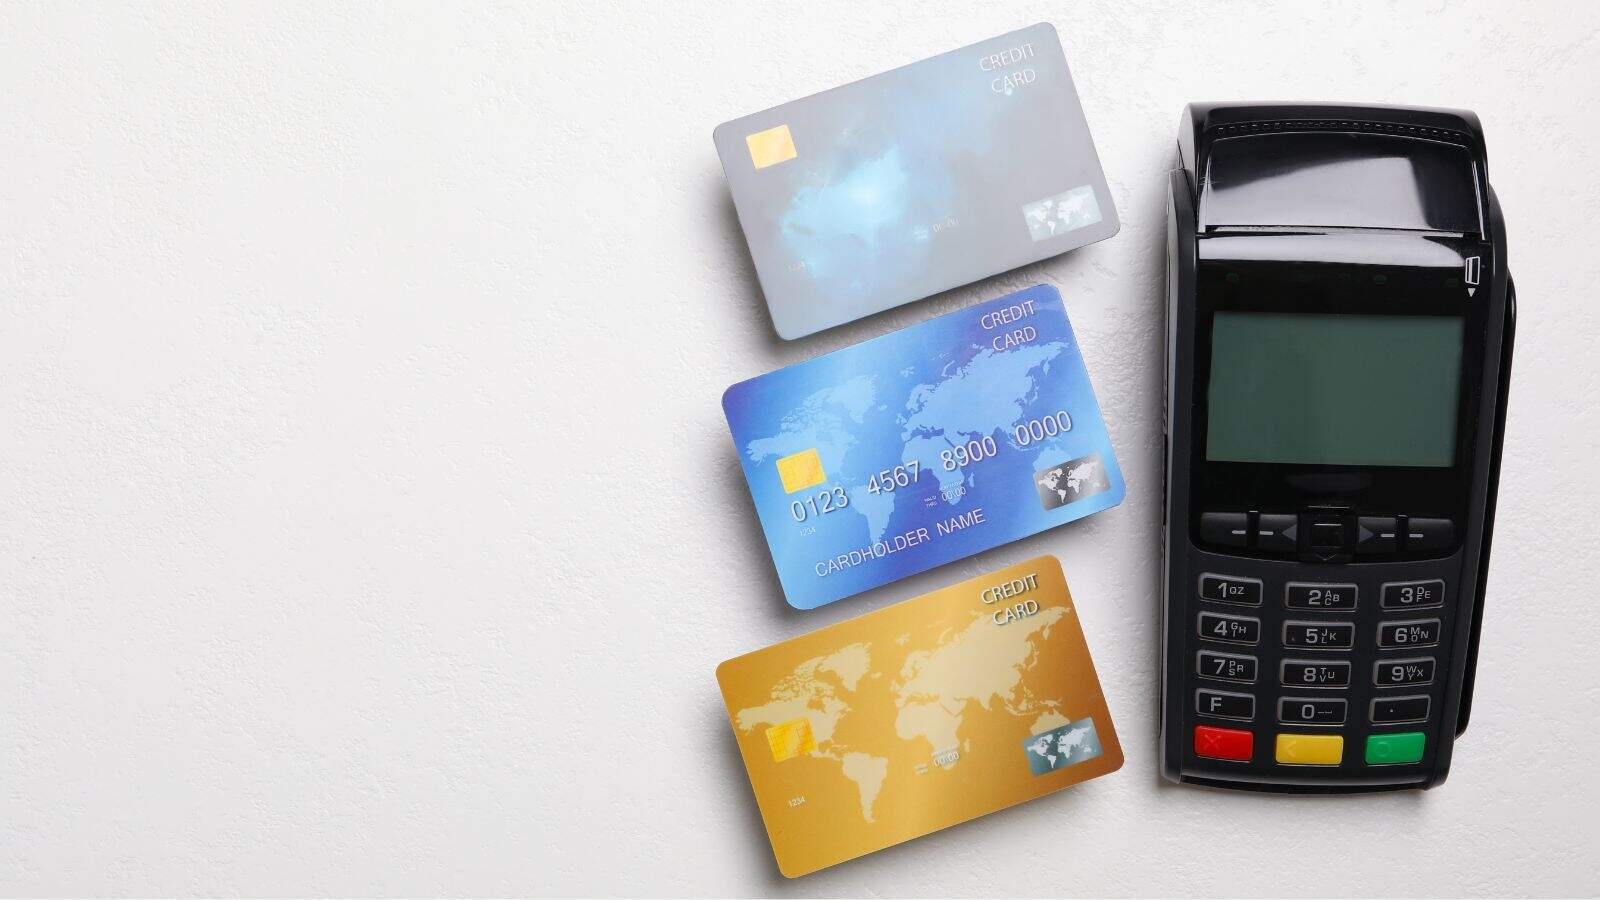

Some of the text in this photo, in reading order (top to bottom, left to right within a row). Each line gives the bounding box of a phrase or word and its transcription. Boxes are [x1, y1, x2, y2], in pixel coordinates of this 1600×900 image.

[979, 43, 1034, 71] CREDIT
[991, 69, 1036, 94] CARD
[981, 299, 1034, 330] CREDIT
[992, 326, 1036, 351] CARD
[791, 410, 1073, 522] 0123 4567 8900 0000
[814, 508, 986, 577] CARDHOLDER NAME
[981, 573, 1038, 604] CREDIT
[993, 600, 1040, 625] CARD
[1210, 697, 1222, 712] F
